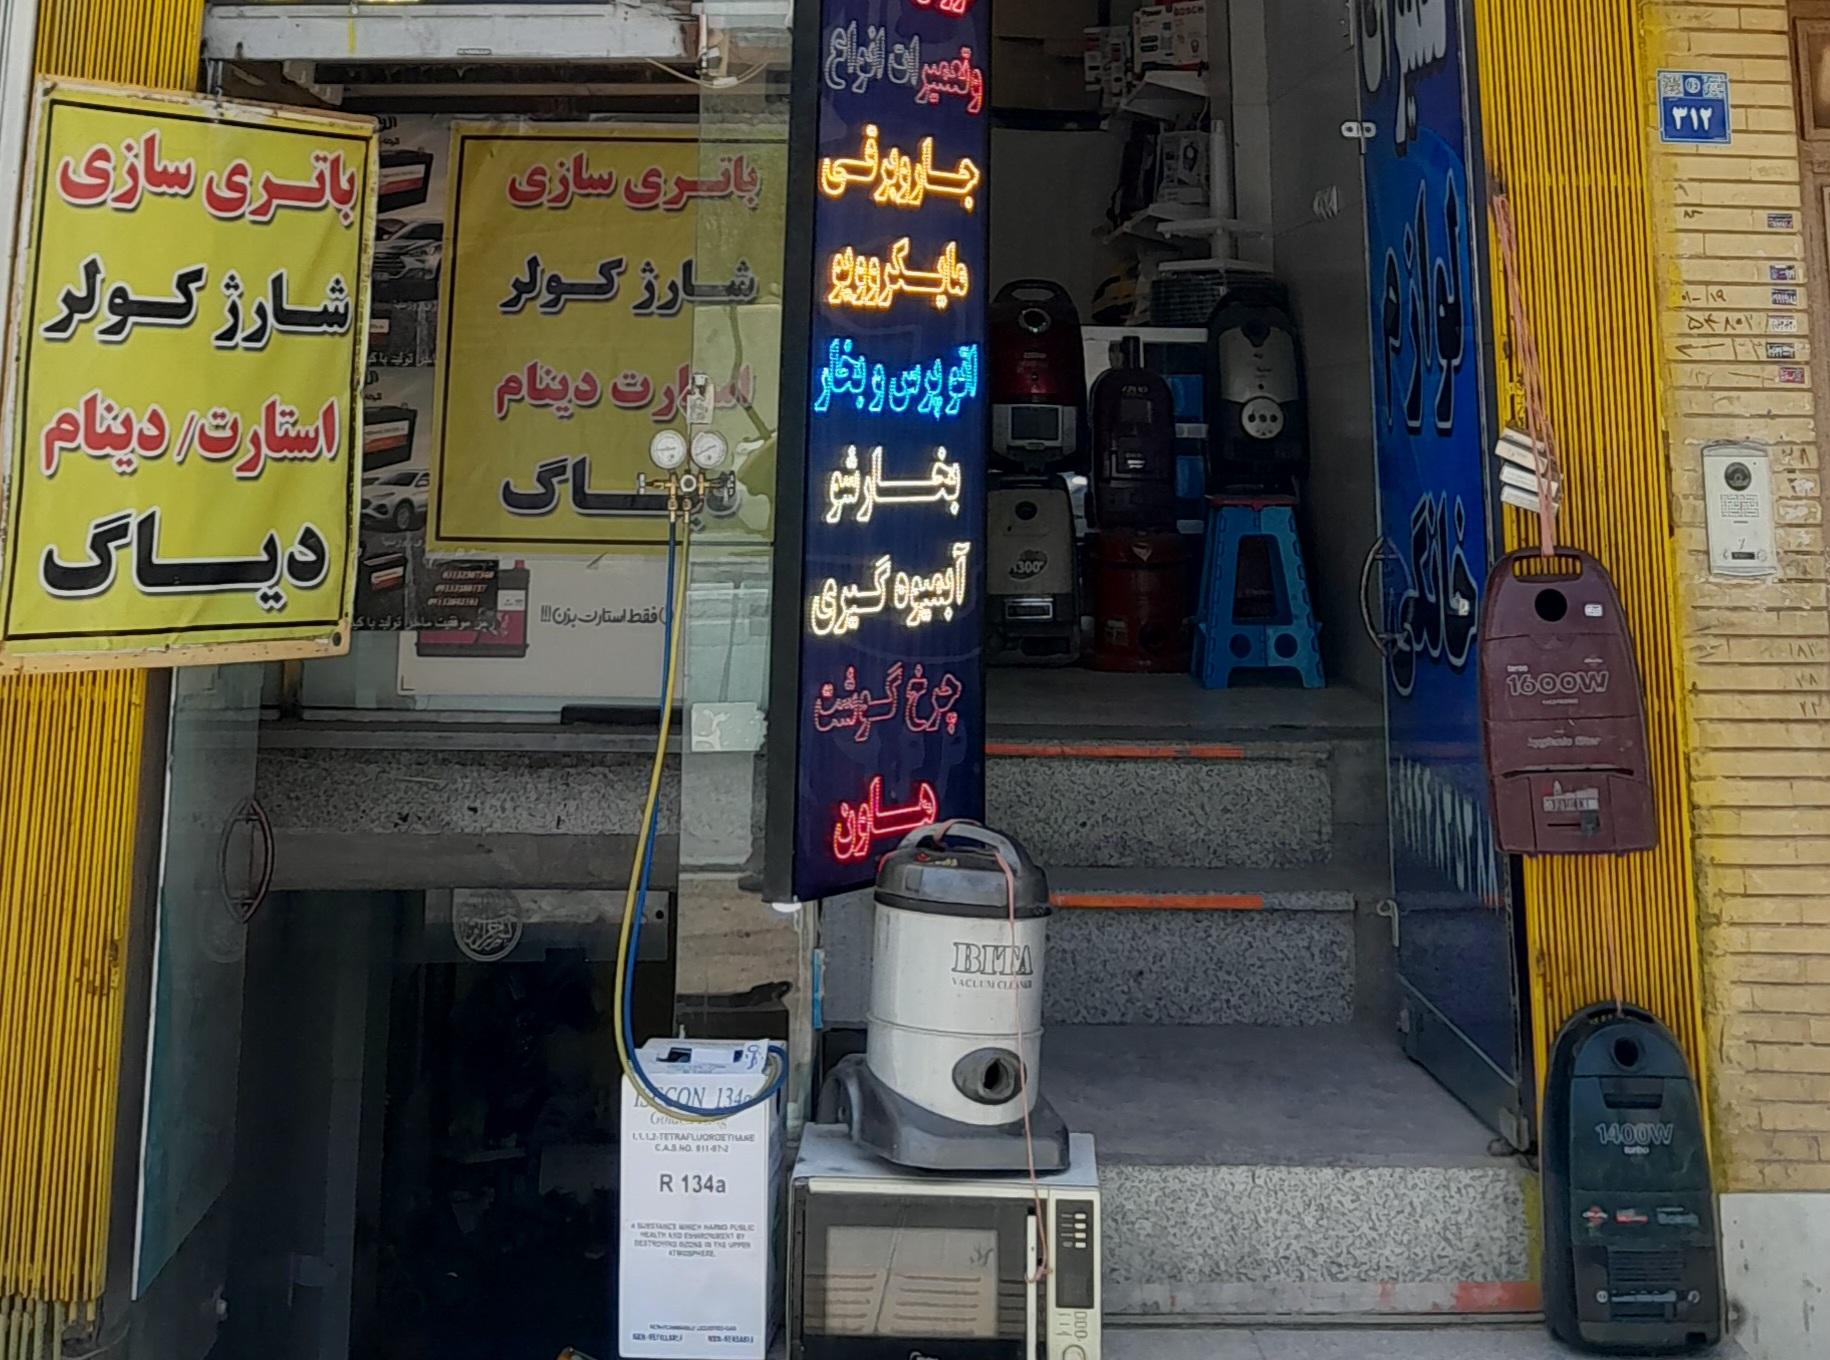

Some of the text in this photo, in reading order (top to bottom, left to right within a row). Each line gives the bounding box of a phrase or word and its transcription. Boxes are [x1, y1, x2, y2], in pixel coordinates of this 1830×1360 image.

[825, 20, 885, 93] انواع
[1671, 106, 1713, 131] ۳۱۲
[58, 128, 359, 226] باتری سازی
[506, 152, 762, 213] باتری سازی
[41, 257, 351, 351] شارژ کولر
[500, 252, 760, 317] شارژ کولر
[1382, 168, 1464, 434] لوازم
[495, 361, 600, 420] دینام
[813, 337, 978, 420] اتو پرس و بخار
[42, 390, 168, 479] دینام
[41, 506, 331, 613] دیاگ
[811, 540, 972, 636] آبمیوه گیری
[1391, 488, 1478, 698] خانگی
[577, 607, 627, 626] استارت
[814, 662, 963, 742] چرخ گوشت
[1506, 671, 1609, 696] 1600W
[832, 775, 938, 861] هاون
[951, 941, 1034, 976] BITA
[1595, 1122, 1675, 1145] 1400W
[660, 1173, 726, 1194] R 134a
